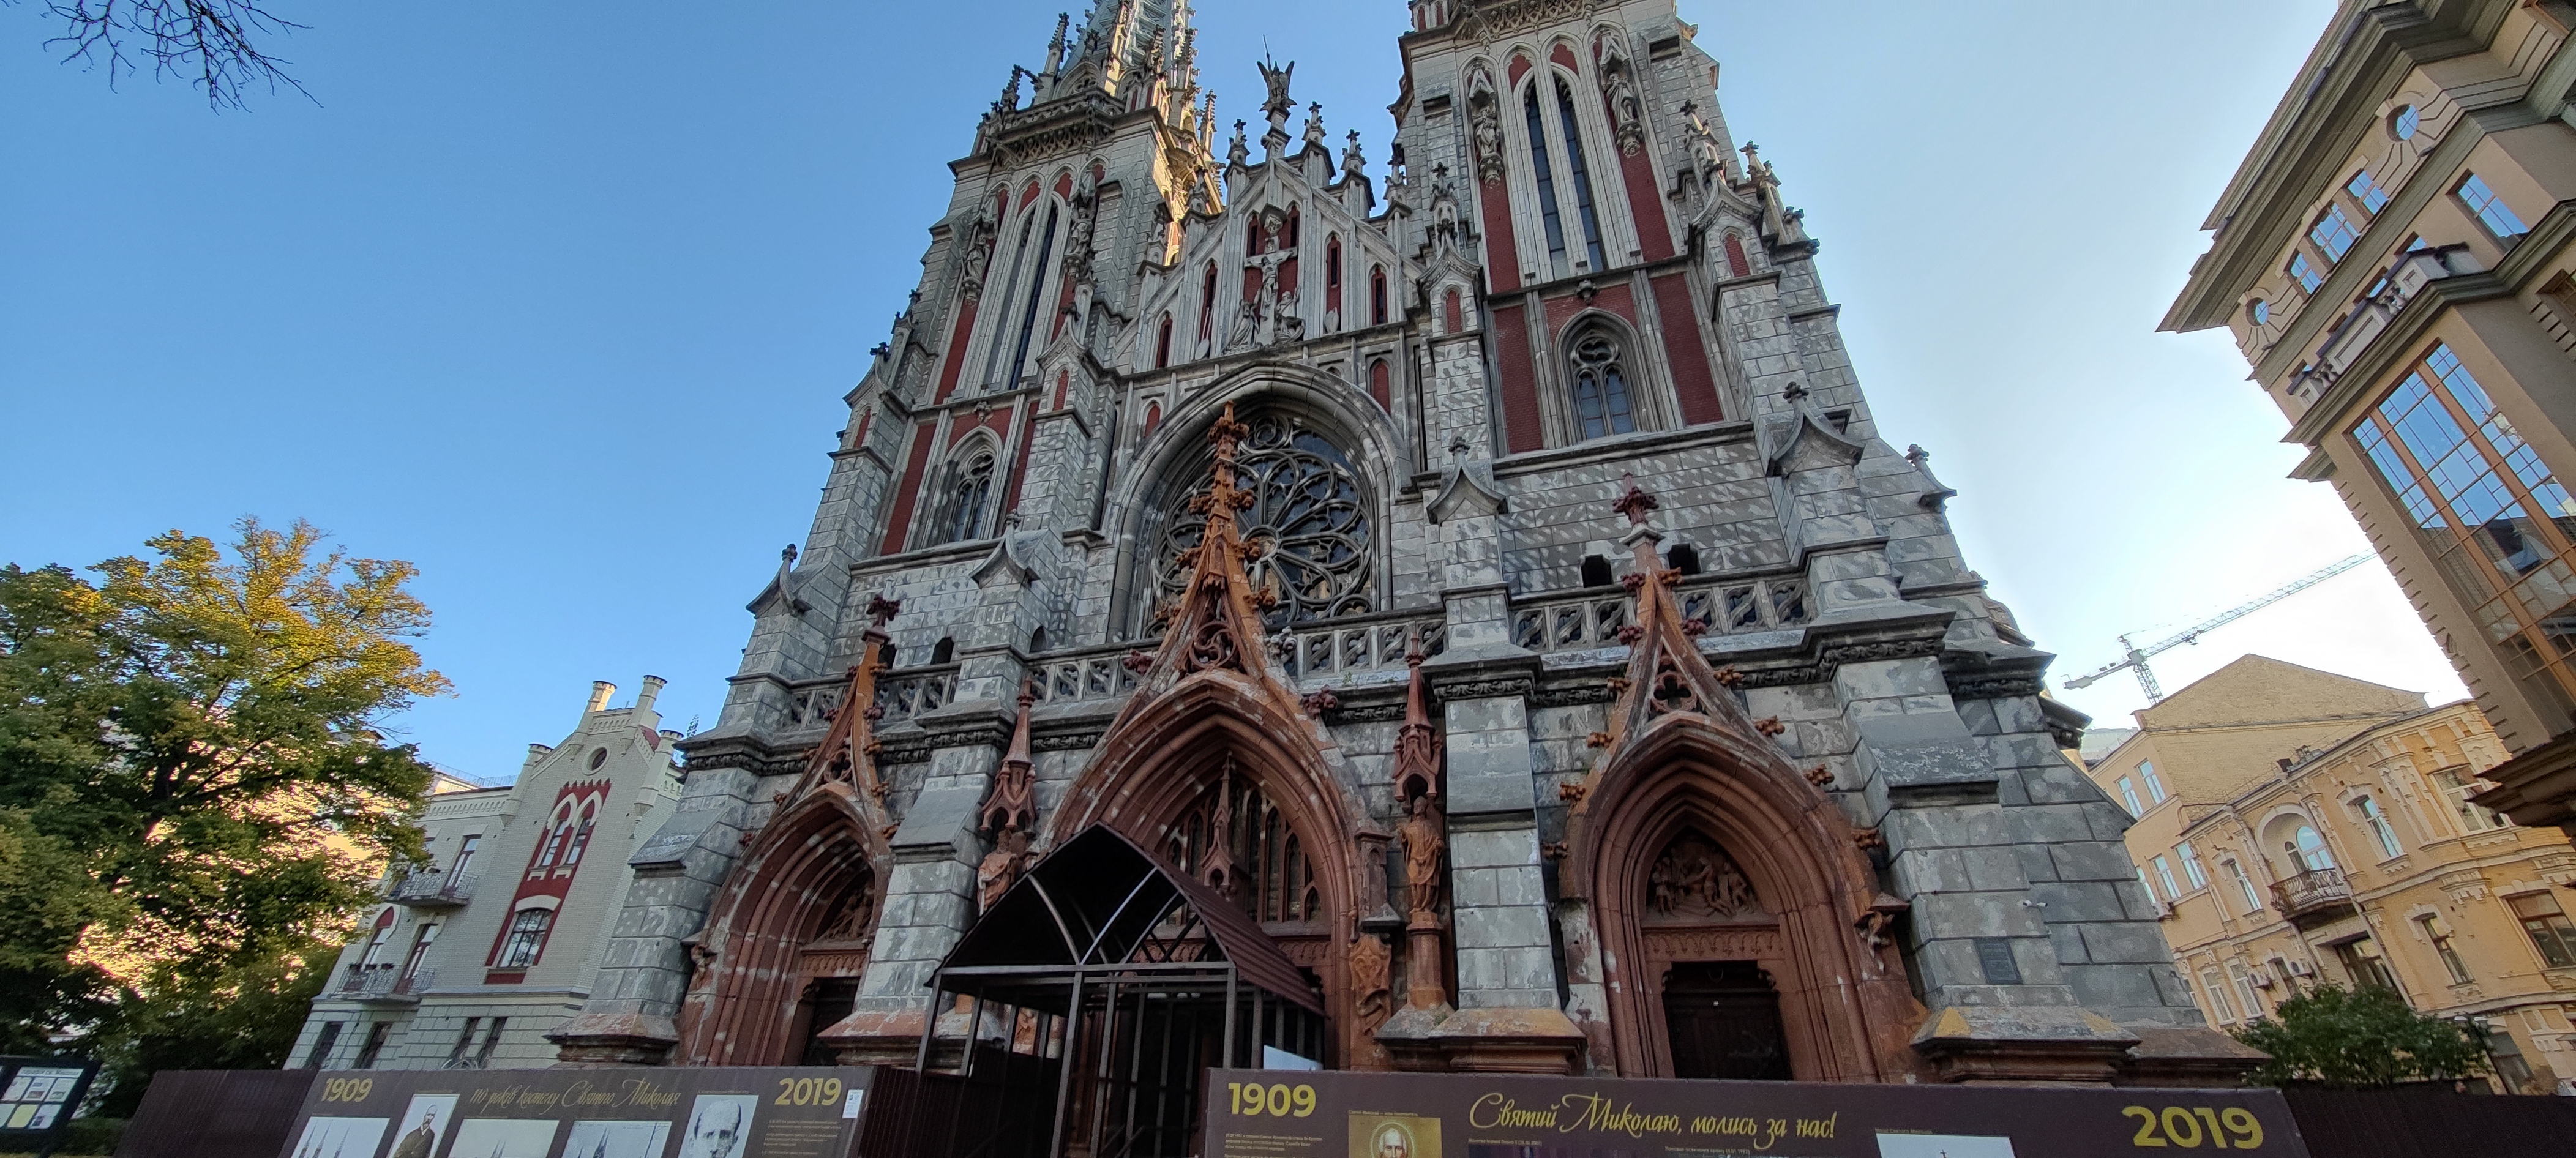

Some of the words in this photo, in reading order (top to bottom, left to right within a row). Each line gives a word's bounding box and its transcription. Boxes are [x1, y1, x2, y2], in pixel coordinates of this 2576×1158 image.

[321, 1078, 373, 1102] 1909
[516, 1085, 560, 1115] костелу
[561, 1080, 616, 1107] Святого
[612, 1077, 681, 1110] Миколая
[774, 1078, 842, 1105] 2019
[1228, 1083, 1316, 1118] 1909
[1469, 1093, 1560, 1128] Святий
[1559, 1091, 1682, 1138] Миколаю,
[1690, 1116, 1758, 1135] молись
[1753, 1118, 1788, 1150] за
[1796, 1111, 1837, 1138] нас!
[2122, 1105, 2263, 1149] 2019
